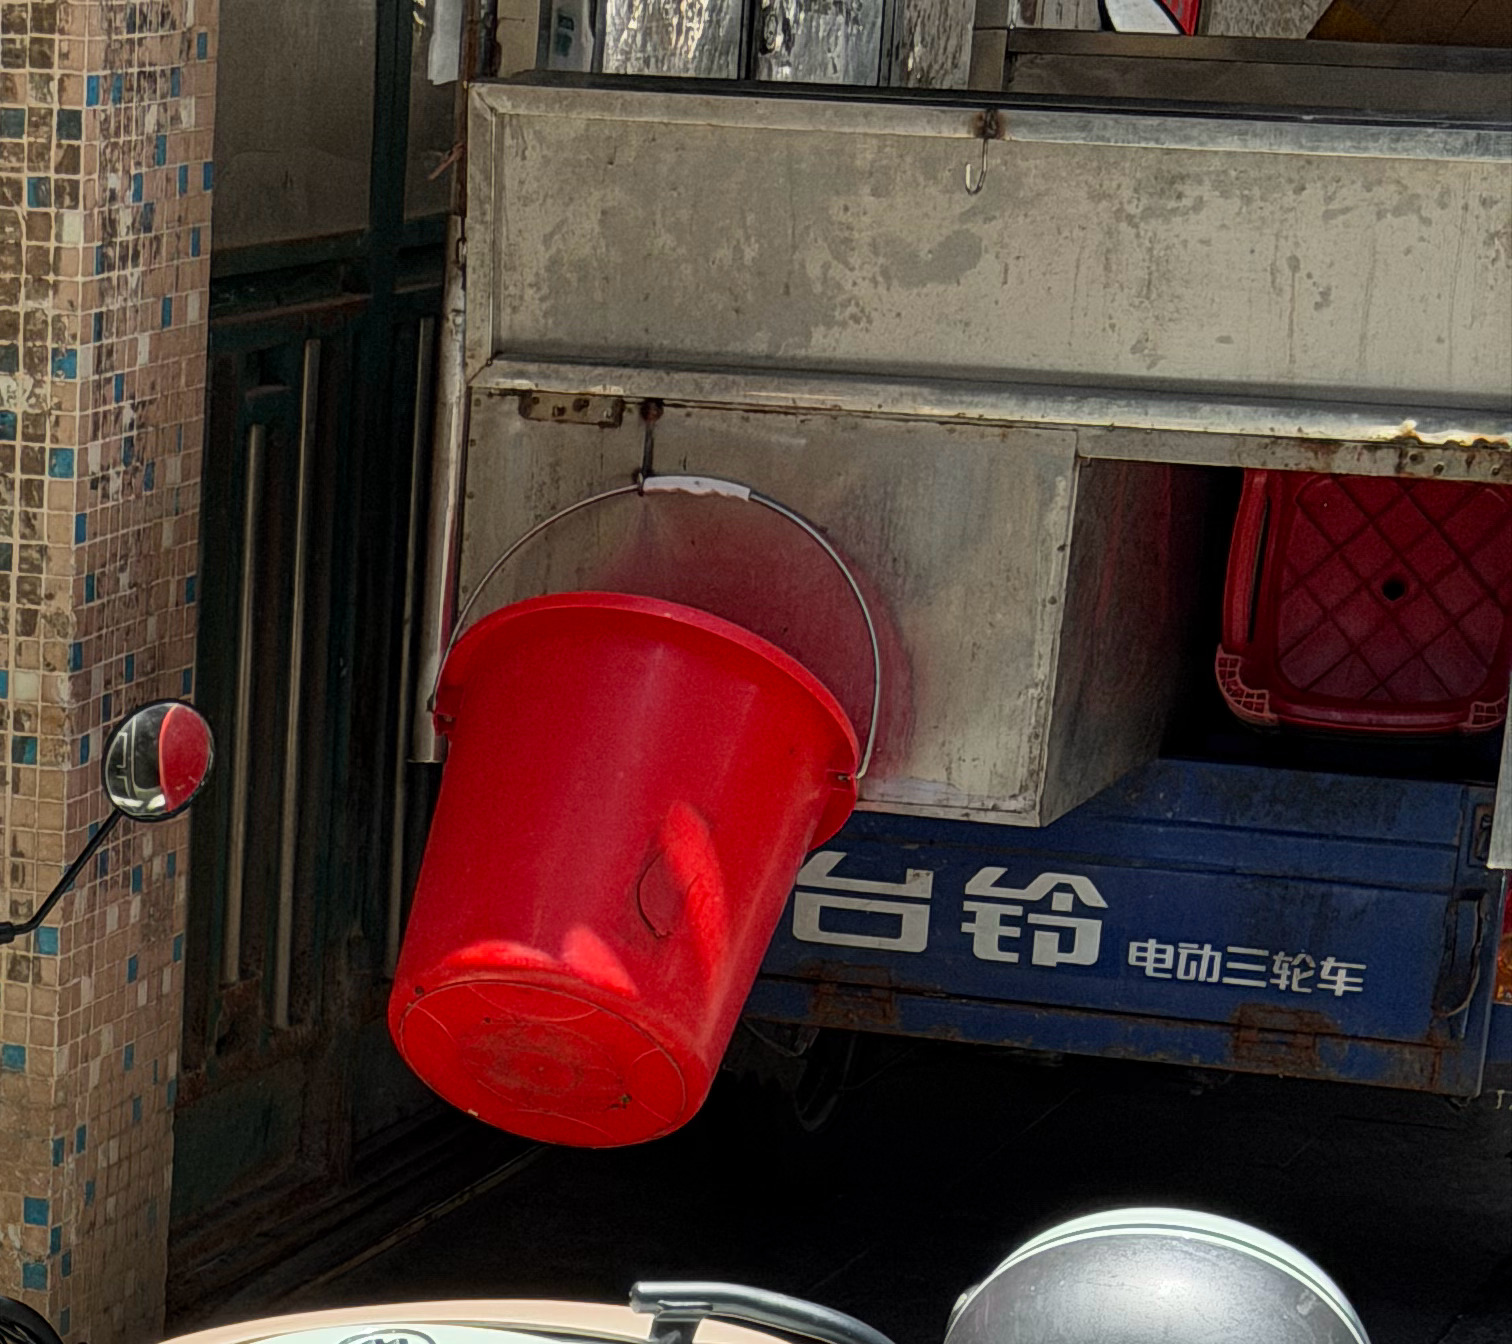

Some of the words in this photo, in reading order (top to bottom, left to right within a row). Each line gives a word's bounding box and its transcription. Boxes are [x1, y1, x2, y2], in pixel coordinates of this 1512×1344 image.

[791, 850, 1108, 967] 台铃
[1128, 938, 1367, 996] 电动三轮车
